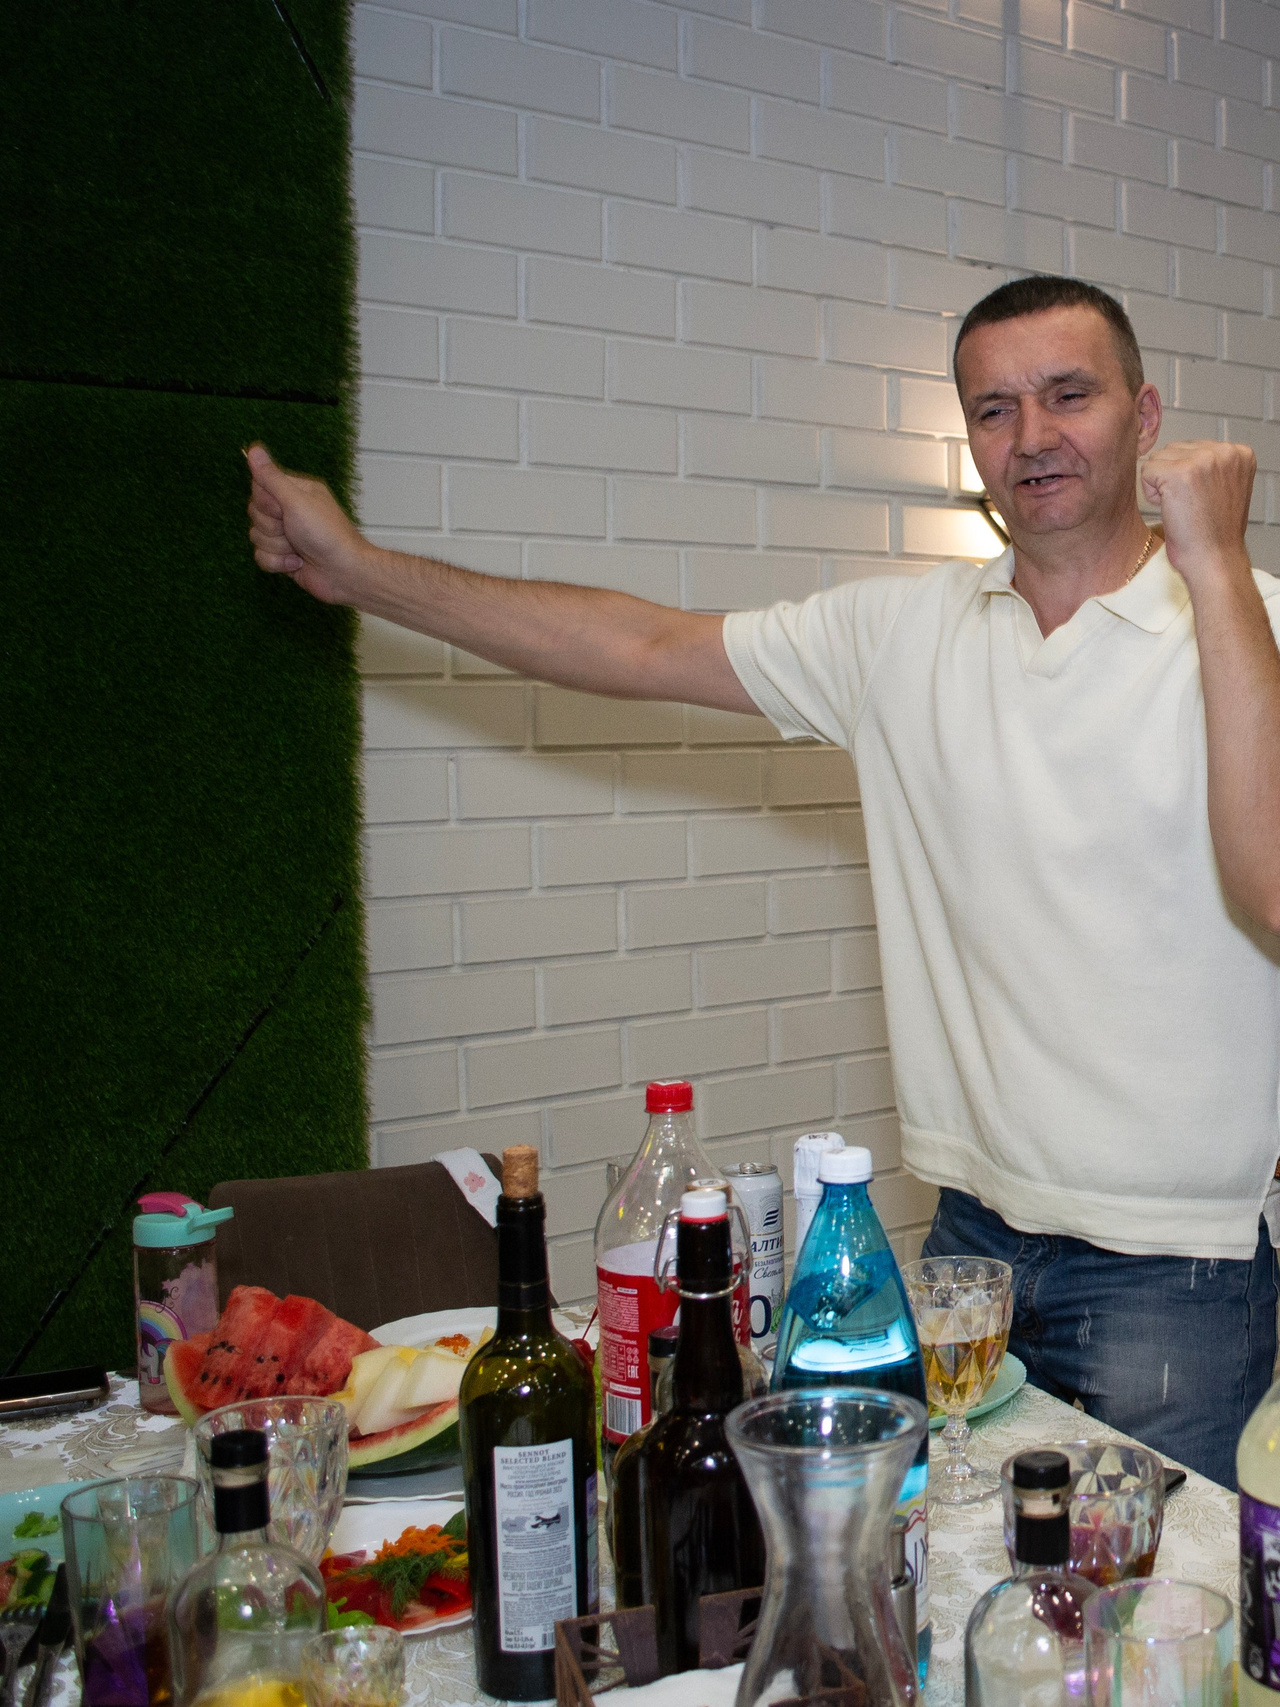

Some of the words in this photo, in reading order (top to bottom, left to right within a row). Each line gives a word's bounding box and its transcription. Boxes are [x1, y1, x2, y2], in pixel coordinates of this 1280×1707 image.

[751, 1236, 783, 1253] АЛТИ
[500, 1457, 540, 1465] SELECTED
[542, 1451, 567, 1462] BLEND
[518, 1449, 550, 1458] SENNOT
